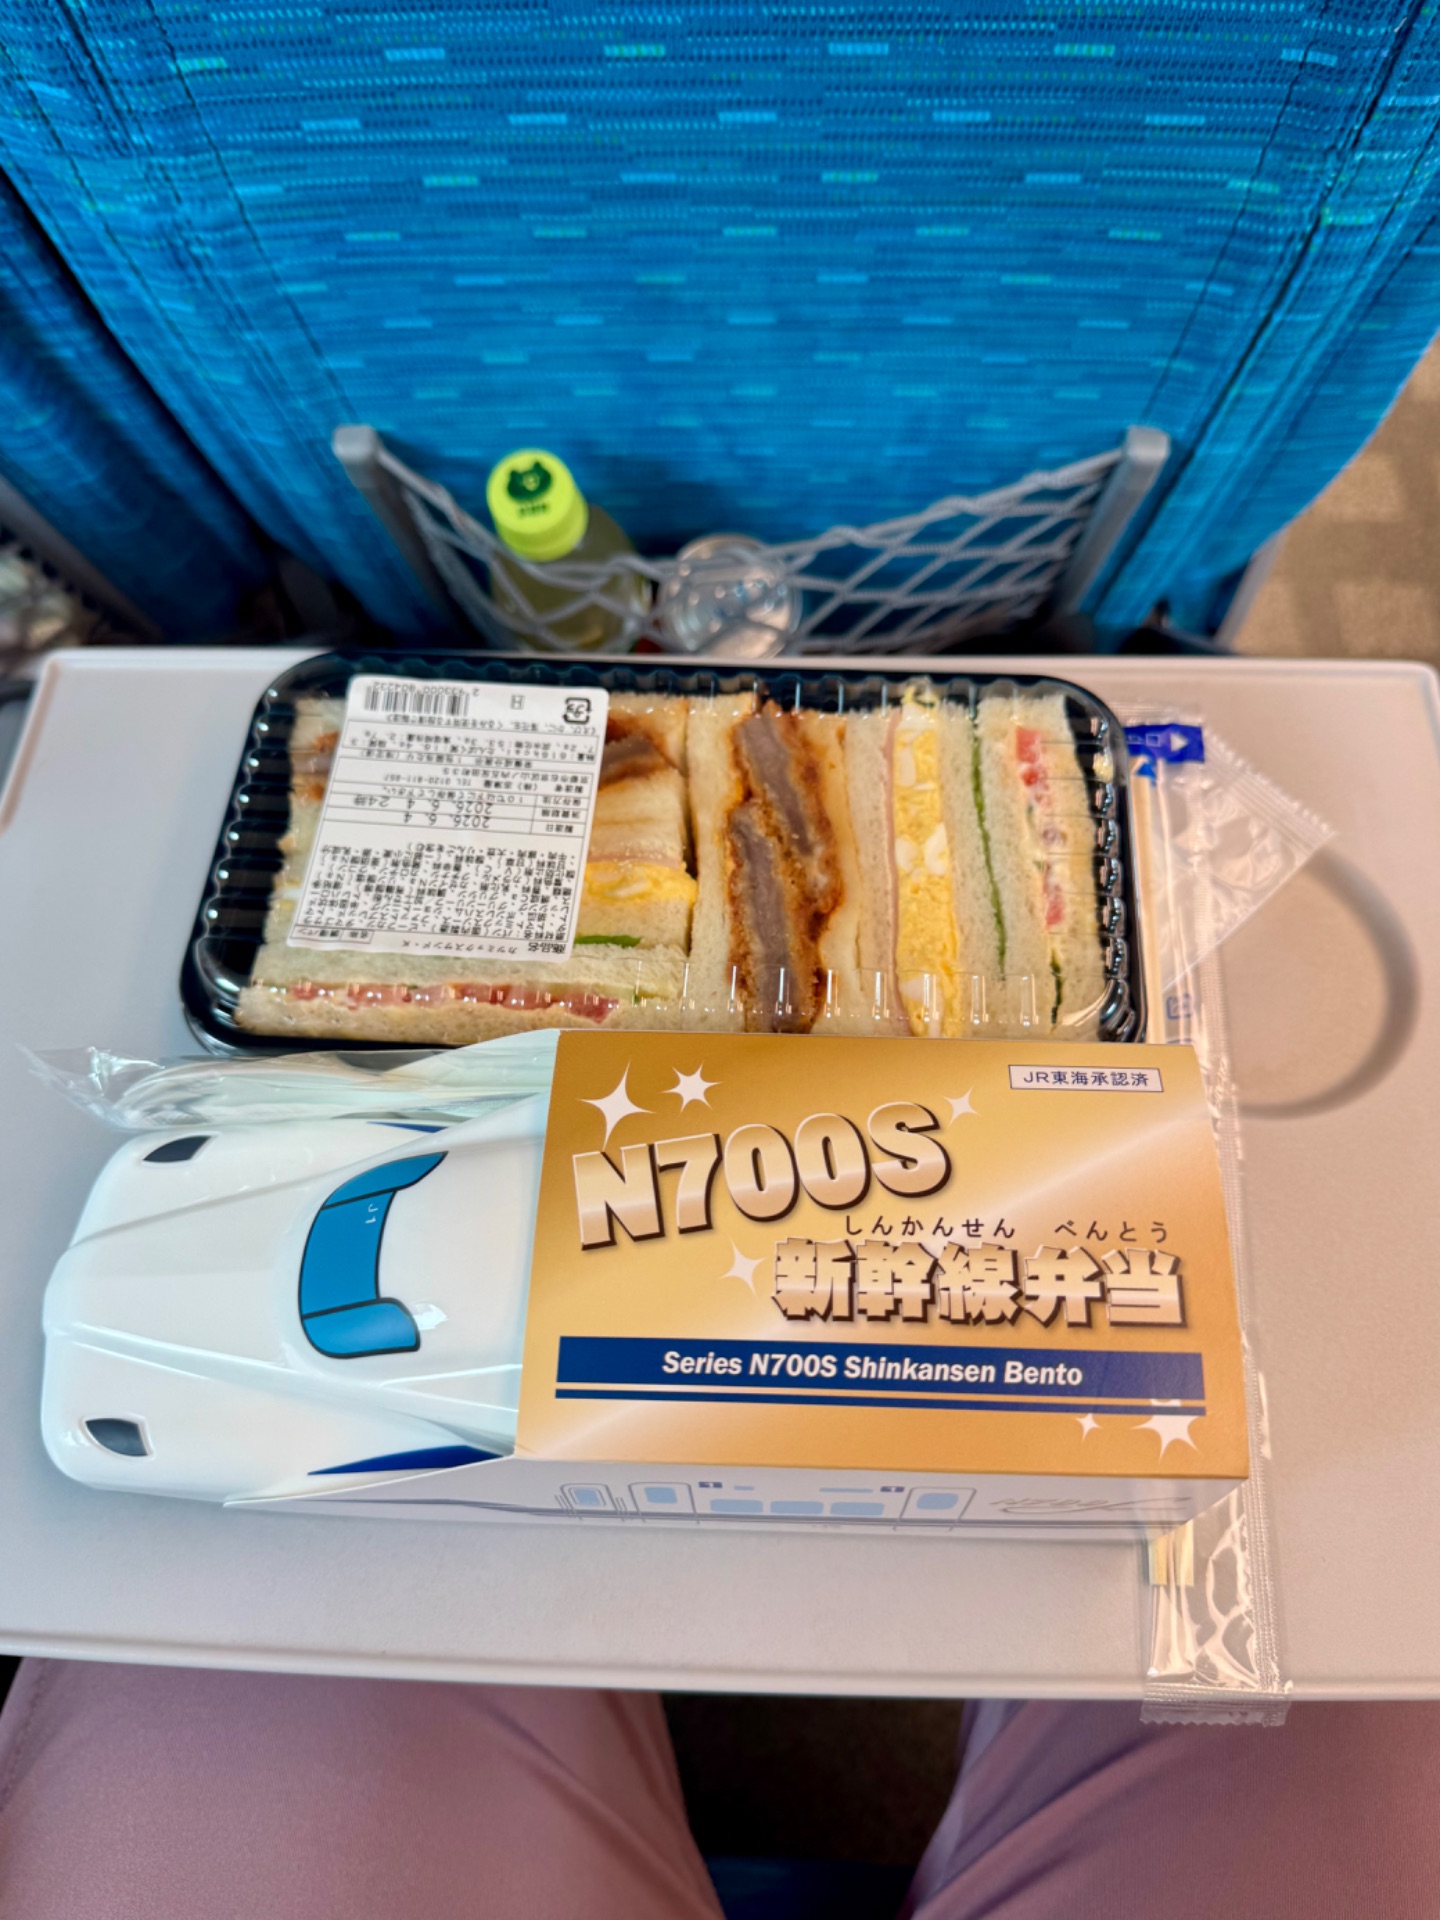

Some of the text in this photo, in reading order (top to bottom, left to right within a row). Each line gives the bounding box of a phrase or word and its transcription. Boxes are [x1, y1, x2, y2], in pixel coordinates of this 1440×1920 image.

[1023, 1069, 1149, 1087] JR東海承認済
[572, 1101, 953, 1251] N700S
[845, 1214, 1168, 1243] しんかんせん べんとう
[772, 1237, 1188, 1328] 新幹線弁当
[662, 1351, 1083, 1386] Series N700S Shinkansen Bento
